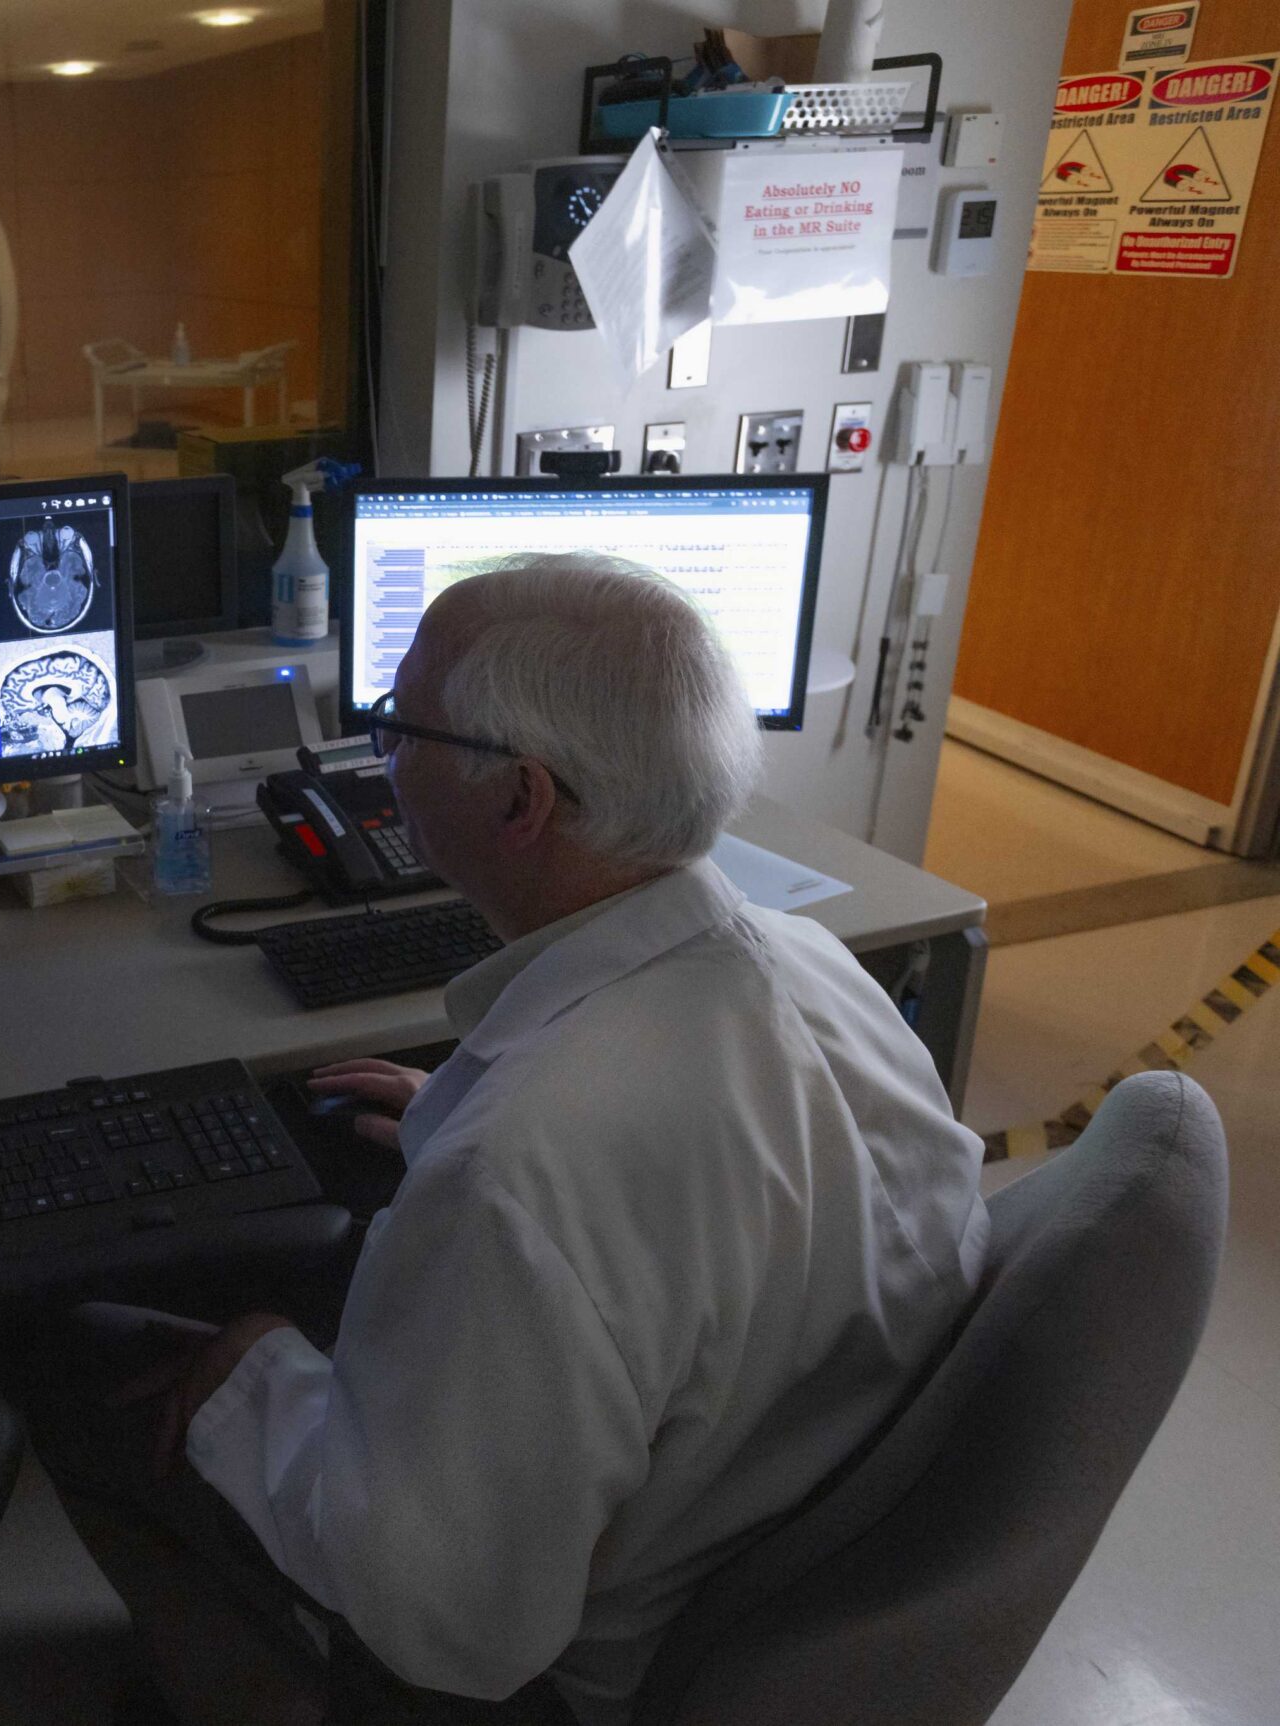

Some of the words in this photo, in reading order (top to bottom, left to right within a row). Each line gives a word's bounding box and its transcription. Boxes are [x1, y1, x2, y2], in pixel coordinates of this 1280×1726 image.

[1165, 70, 1256, 99] DANGER!
[1055, 81, 1131, 107] DANGER!
[1051, 114, 1104, 129] estricted
[1106, 113, 1135, 125] Area
[1149, 107, 1224, 126] Restricted
[1226, 106, 1261, 121] Area
[901, 167, 926, 176] oom
[762, 182, 836, 198] Absolutely
[840, 181, 861, 194] NO
[1038, 197, 1073, 206] werful
[1076, 196, 1119, 206] Magnet
[744, 204, 791, 219] Eating
[794, 206, 809, 216] or
[813, 201, 874, 215] Drinking
[1042, 208, 1080, 217] Always
[1083, 207, 1098, 217] On
[1129, 205, 1186, 215] Powerful
[1188, 205, 1240, 216] Magnet
[753, 225, 767, 237] in
[772, 223, 794, 236] the
[799, 221, 822, 234] MR
[826, 219, 862, 232] Suite
[1149, 217, 1194, 228] Always
[1197, 217, 1215, 228] On
[1203, 237, 1231, 251] Entry
